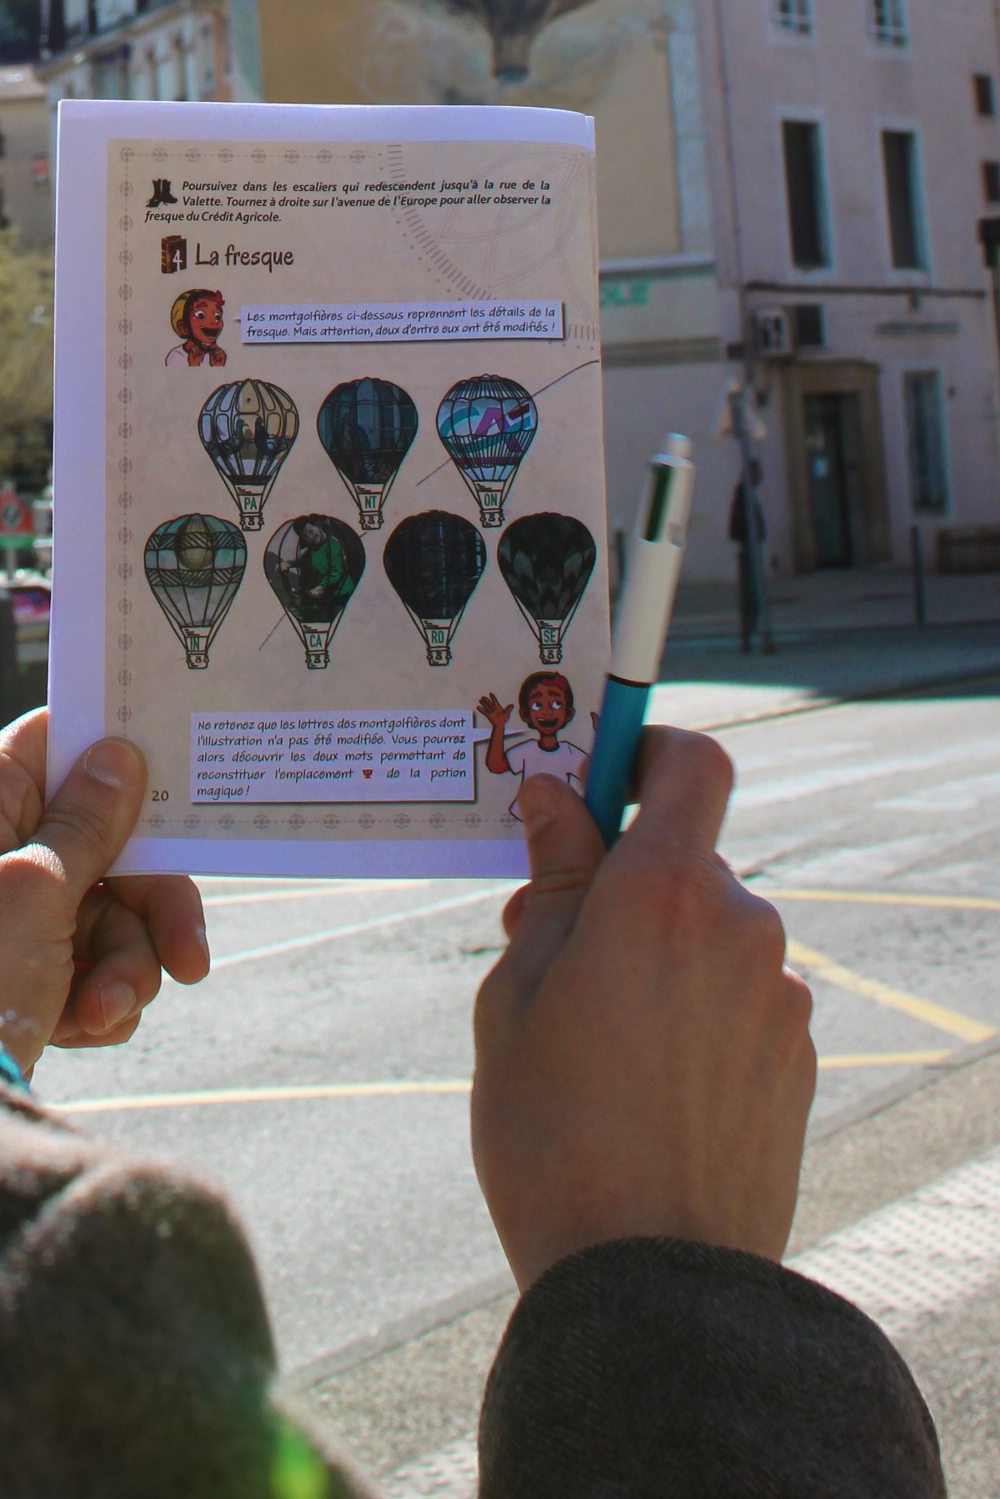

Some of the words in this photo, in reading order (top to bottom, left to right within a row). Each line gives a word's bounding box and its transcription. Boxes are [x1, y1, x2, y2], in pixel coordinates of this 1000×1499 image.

[182, 181, 238, 192] Poursuivez
[243, 182, 267, 192] dans
[273, 182, 287, 192] les
[293, 182, 336, 192] escaliers
[342, 182, 359, 194] qui
[364, 181, 436, 192] redescendent
[440, 180, 478, 192] jusqu'à
[484, 180, 494, 190] la
[522, 180, 535, 190] de
[540, 180, 550, 190] la
[182, 196, 223, 206] Valette.
[227, 197, 267, 206] Tournez
[270, 196, 276, 206] à
[278, 197, 310, 206] droite
[331, 196, 375, 206] l'avenue
[378, 196, 390, 206] de
[394, 195, 438, 208] l'Europe
[440, 197, 464, 207] pour
[467, 194, 492, 204] aller
[494, 195, 539, 205] observer
[541, 195, 550, 205] la
[144, 211, 184, 224] fresque
[186, 212, 199, 222] du
[202, 212, 234, 222] Crédit
[236, 212, 282, 224] Agricole.
[172, 249, 183, 272] 4
[195, 243, 218, 266] La
[225, 244, 294, 273] fresque
[247, 312, 265, 322] Les
[269, 310, 342, 325] montgolfières
[346, 310, 404, 320] ci-dessous
[408, 308, 466, 321] reprennent
[470, 308, 485, 318] les
[489, 306, 524, 317] détails
[529, 307, 541, 316] de
[546, 308, 554, 316] la
[247, 326, 290, 339] fresque.
[294, 326, 317, 336] Mais
[320, 326, 372, 338] attention,
[376, 326, 400, 335] deux
[402, 324, 438, 334] d'entre
[462, 324, 480, 332] ont
[483, 321, 500, 332] été
[503, 321, 548, 332] modifiés
[244, 497, 257, 510] PA
[365, 496, 377, 508] NT
[484, 494, 498, 506] ON
[309, 634, 322, 648] CA
[431, 630, 444, 644] RO
[544, 629, 556, 642] SE
[190, 637, 200, 650] IN
[198, 721, 211, 730] Ne
[214, 720, 255, 730] retenez
[258, 722, 277, 732] que
[280, 720, 295, 729] les
[298, 719, 334, 729] lettres
[337, 718, 356, 728] des
[360, 716, 436, 733] montgolfières
[440, 717, 466, 728] dont
[198, 735, 262, 746] l'illustration
[268, 734, 283, 745] n'a
[288, 737, 309, 748] pas
[314, 733, 332, 745] été
[337, 732, 386, 744] modifiée.
[392, 735, 418, 744] Vous
[423, 736, 466, 748] pourrez
[198, 752, 224, 762] alors
[232, 750, 284, 762] découvrir
[290, 752, 306, 761] les
[312, 751, 338, 761] deux
[345, 751, 373, 760] mots
[380, 750, 446, 764] permettant
[452, 750, 466, 760] de
[198, 769, 266, 780] reconstituer
[275, 768, 354, 783] l'emplacement
[386, 768, 400, 778] de
[410, 768, 420, 778] la
[430, 768, 466, 781] potion
[152, 790, 168, 801] 20
